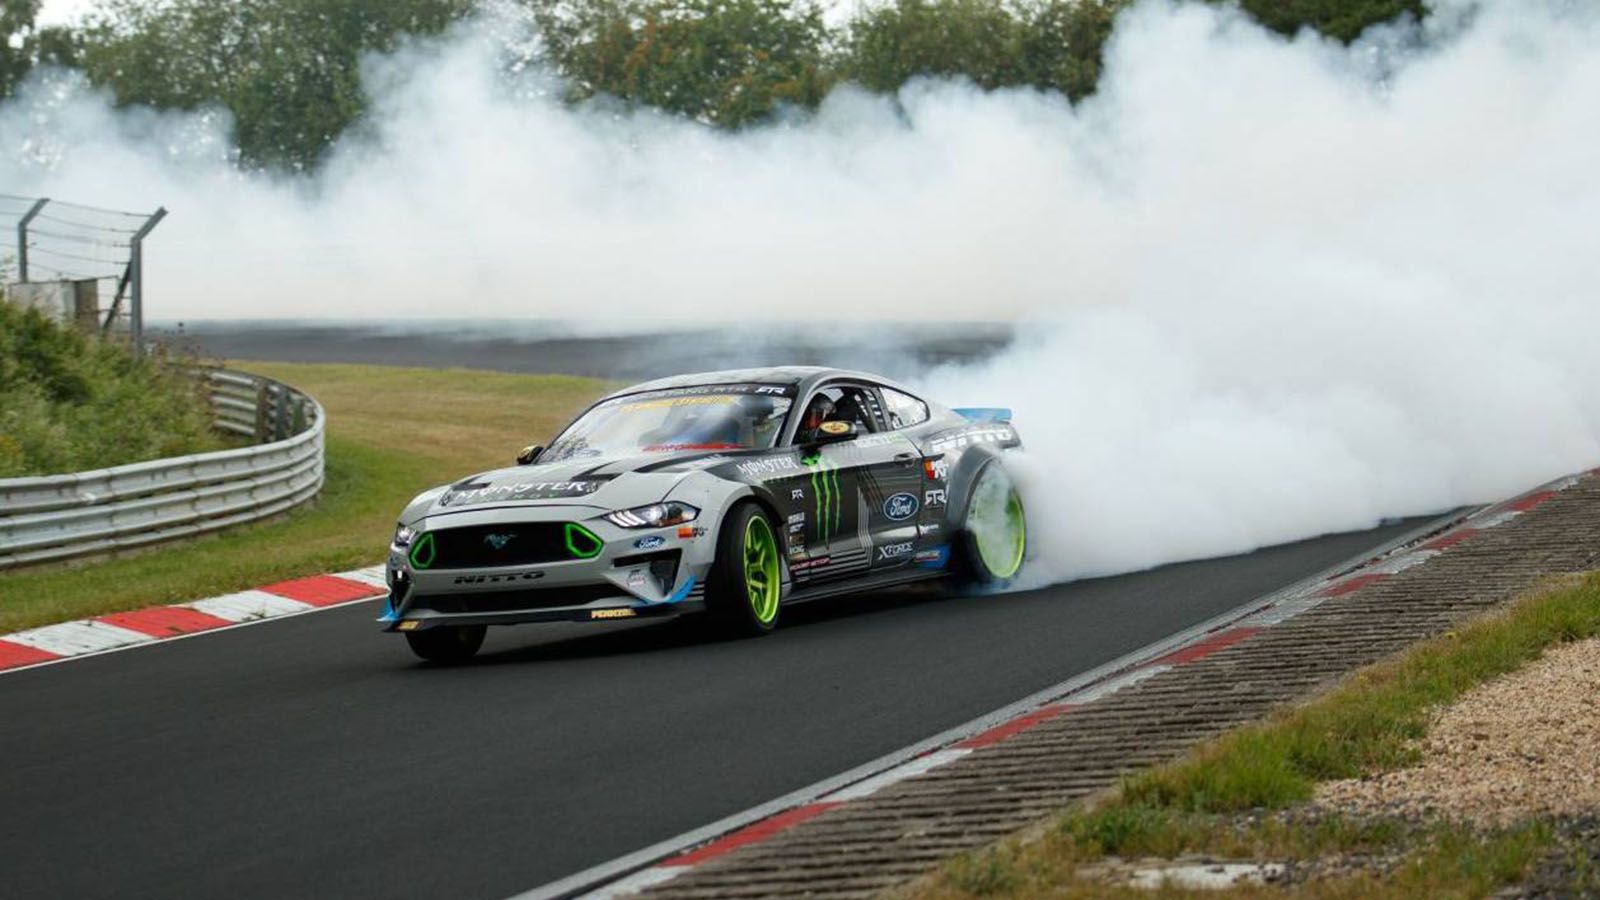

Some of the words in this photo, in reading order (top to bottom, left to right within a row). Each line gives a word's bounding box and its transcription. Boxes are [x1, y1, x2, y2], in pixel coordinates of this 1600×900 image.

[736, 456, 799, 476] MONSTER
[457, 481, 589, 499] MONSTER
[924, 489, 947, 505] RTR
[454, 571, 545, 584] NITTO
